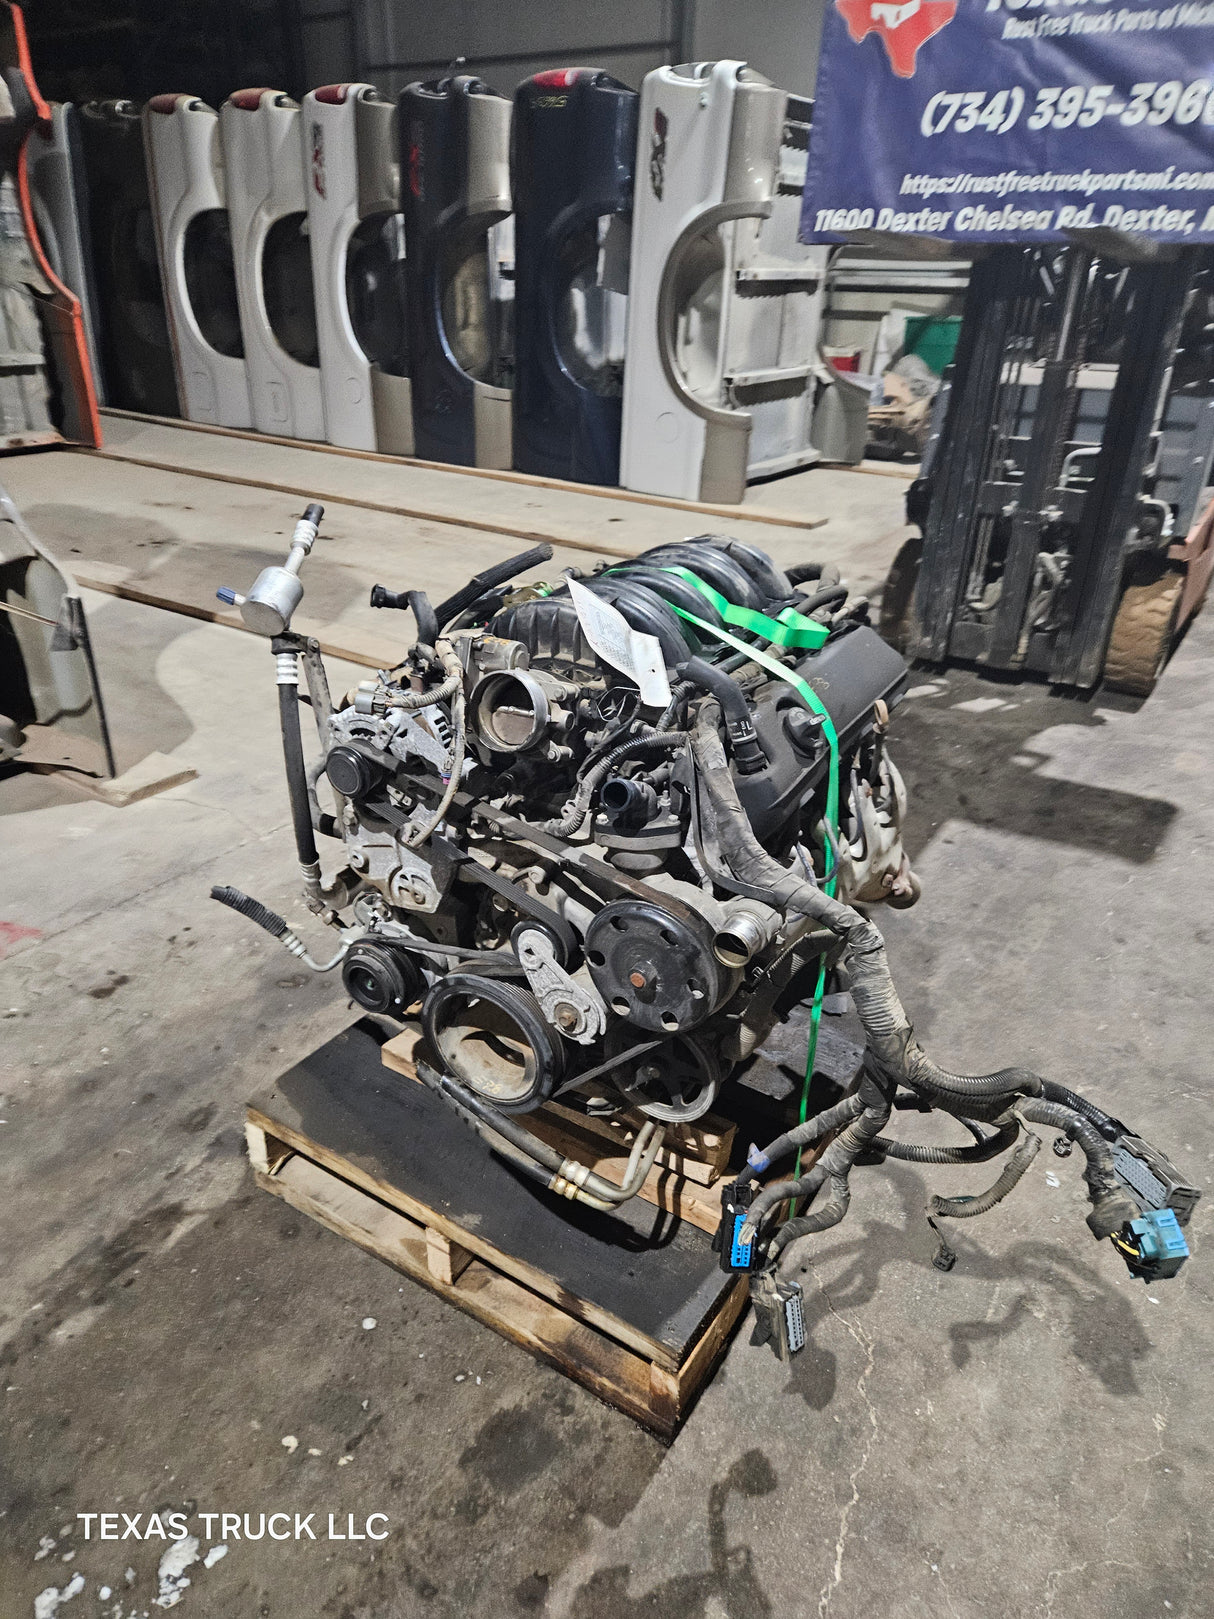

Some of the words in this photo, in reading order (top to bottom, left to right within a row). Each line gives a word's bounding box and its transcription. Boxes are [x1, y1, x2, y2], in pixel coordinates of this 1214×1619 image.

[1036, 14, 1071, 37] Free
[1069, 10, 1115, 35] Truck
[1111, 8, 1160, 32] Parts
[920, 86, 1025, 138] (734)
[813, 208, 875, 232] 11600
[875, 207, 953, 233] Dexter
[954, 204, 1055, 232] Chelsea
